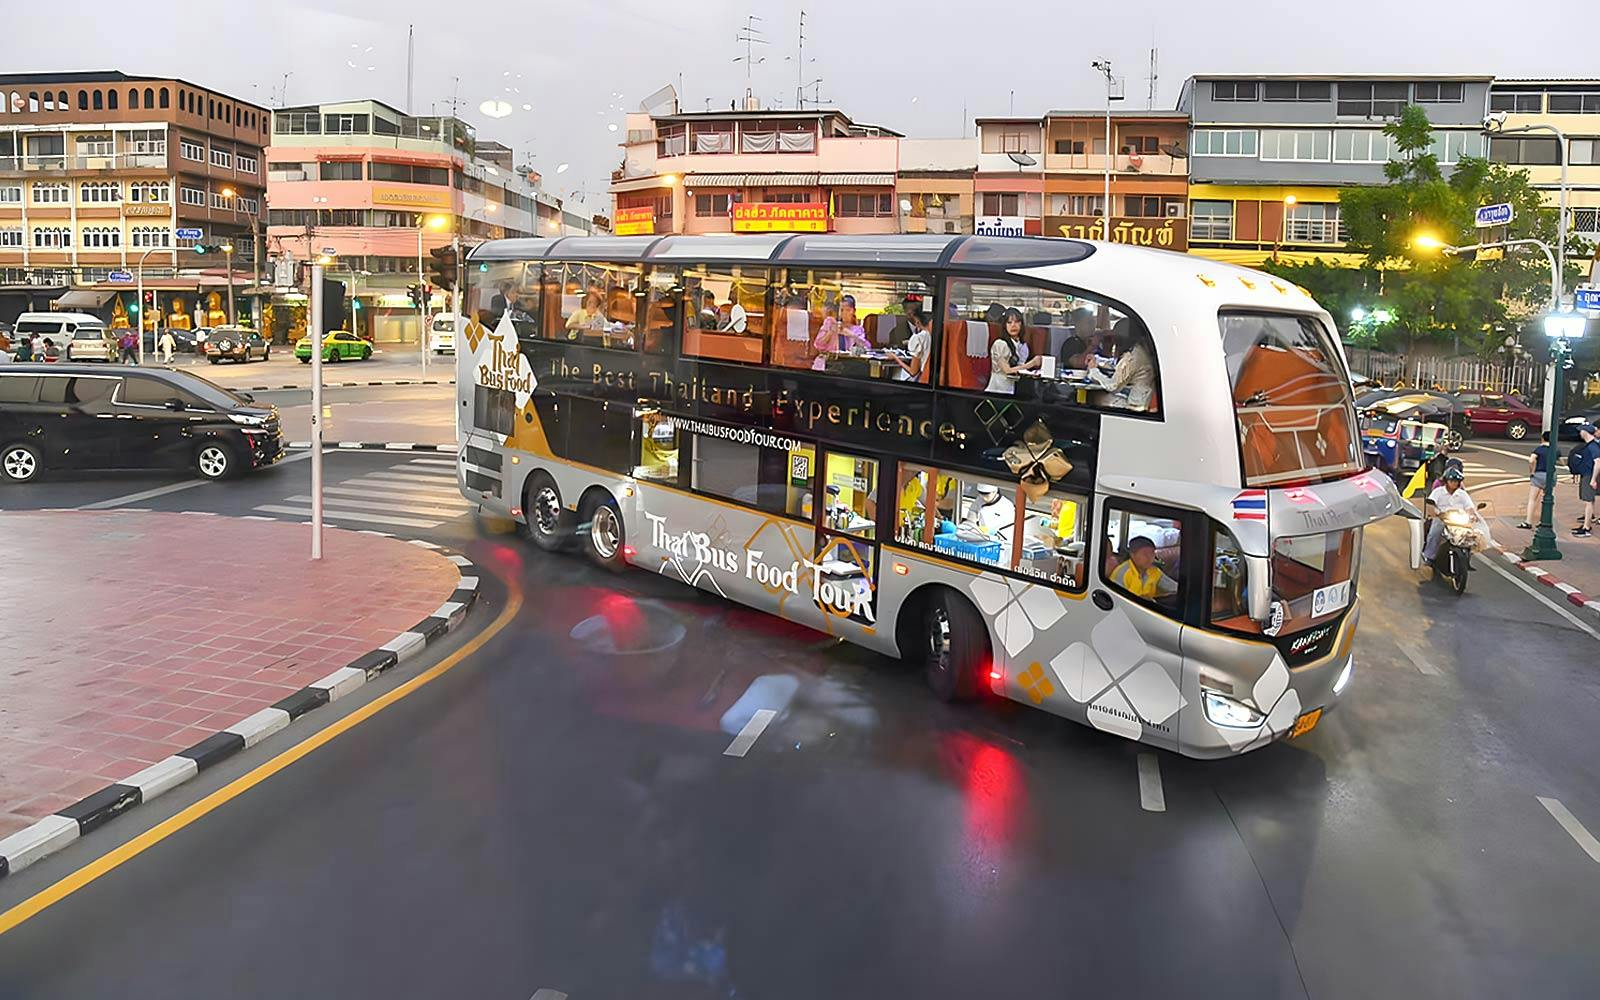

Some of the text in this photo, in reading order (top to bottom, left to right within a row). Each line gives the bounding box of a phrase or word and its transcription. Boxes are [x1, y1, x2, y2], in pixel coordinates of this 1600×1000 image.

[488, 334, 521, 373] Thai
[551, 358, 580, 378] The
[592, 363, 636, 389] Best
[644, 511, 691, 562] Thai
[693, 531, 738, 574] Bus
[745, 548, 800, 595] Food
